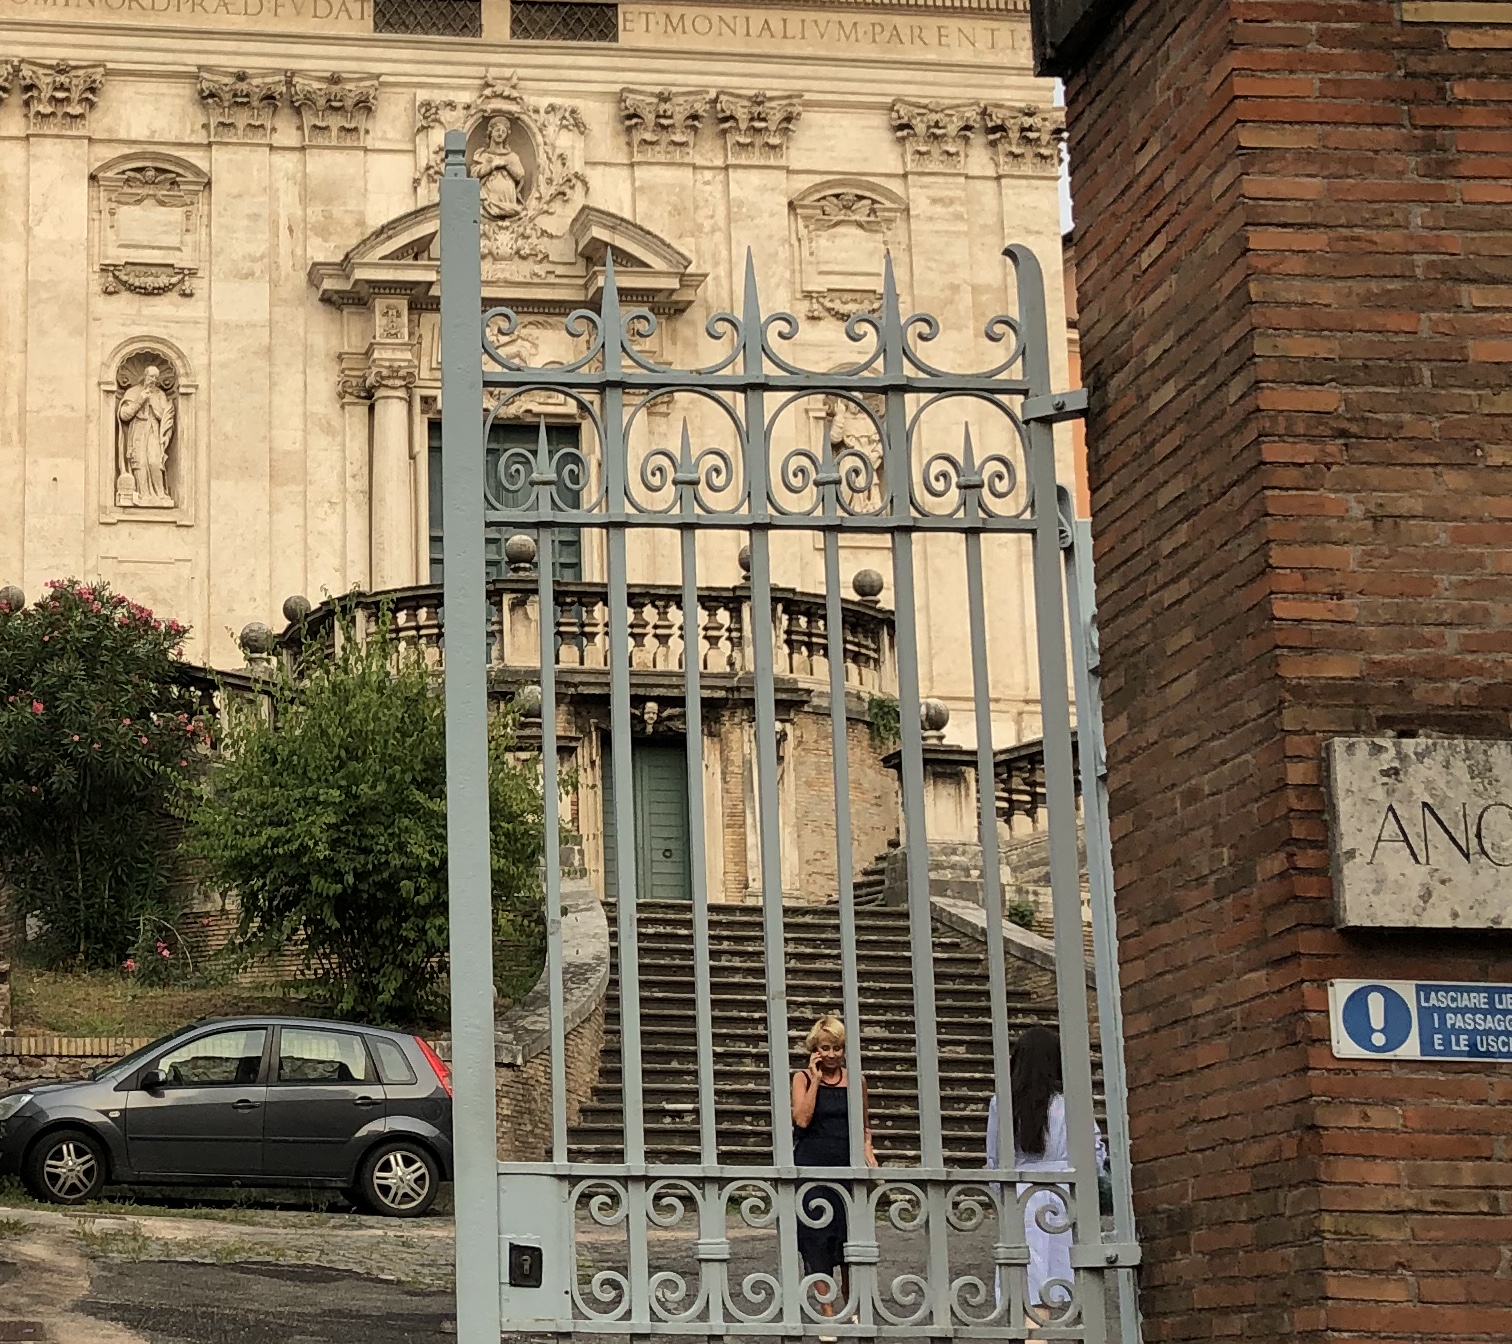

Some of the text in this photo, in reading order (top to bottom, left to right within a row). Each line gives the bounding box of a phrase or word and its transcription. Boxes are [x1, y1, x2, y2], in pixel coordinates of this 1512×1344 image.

[1420, 991, 1490, 1008] LASCIARE
[1433, 1012, 1439, 1029] I
[1433, 1033, 1445, 1050] E
[1451, 1034, 1470, 1051] LE
